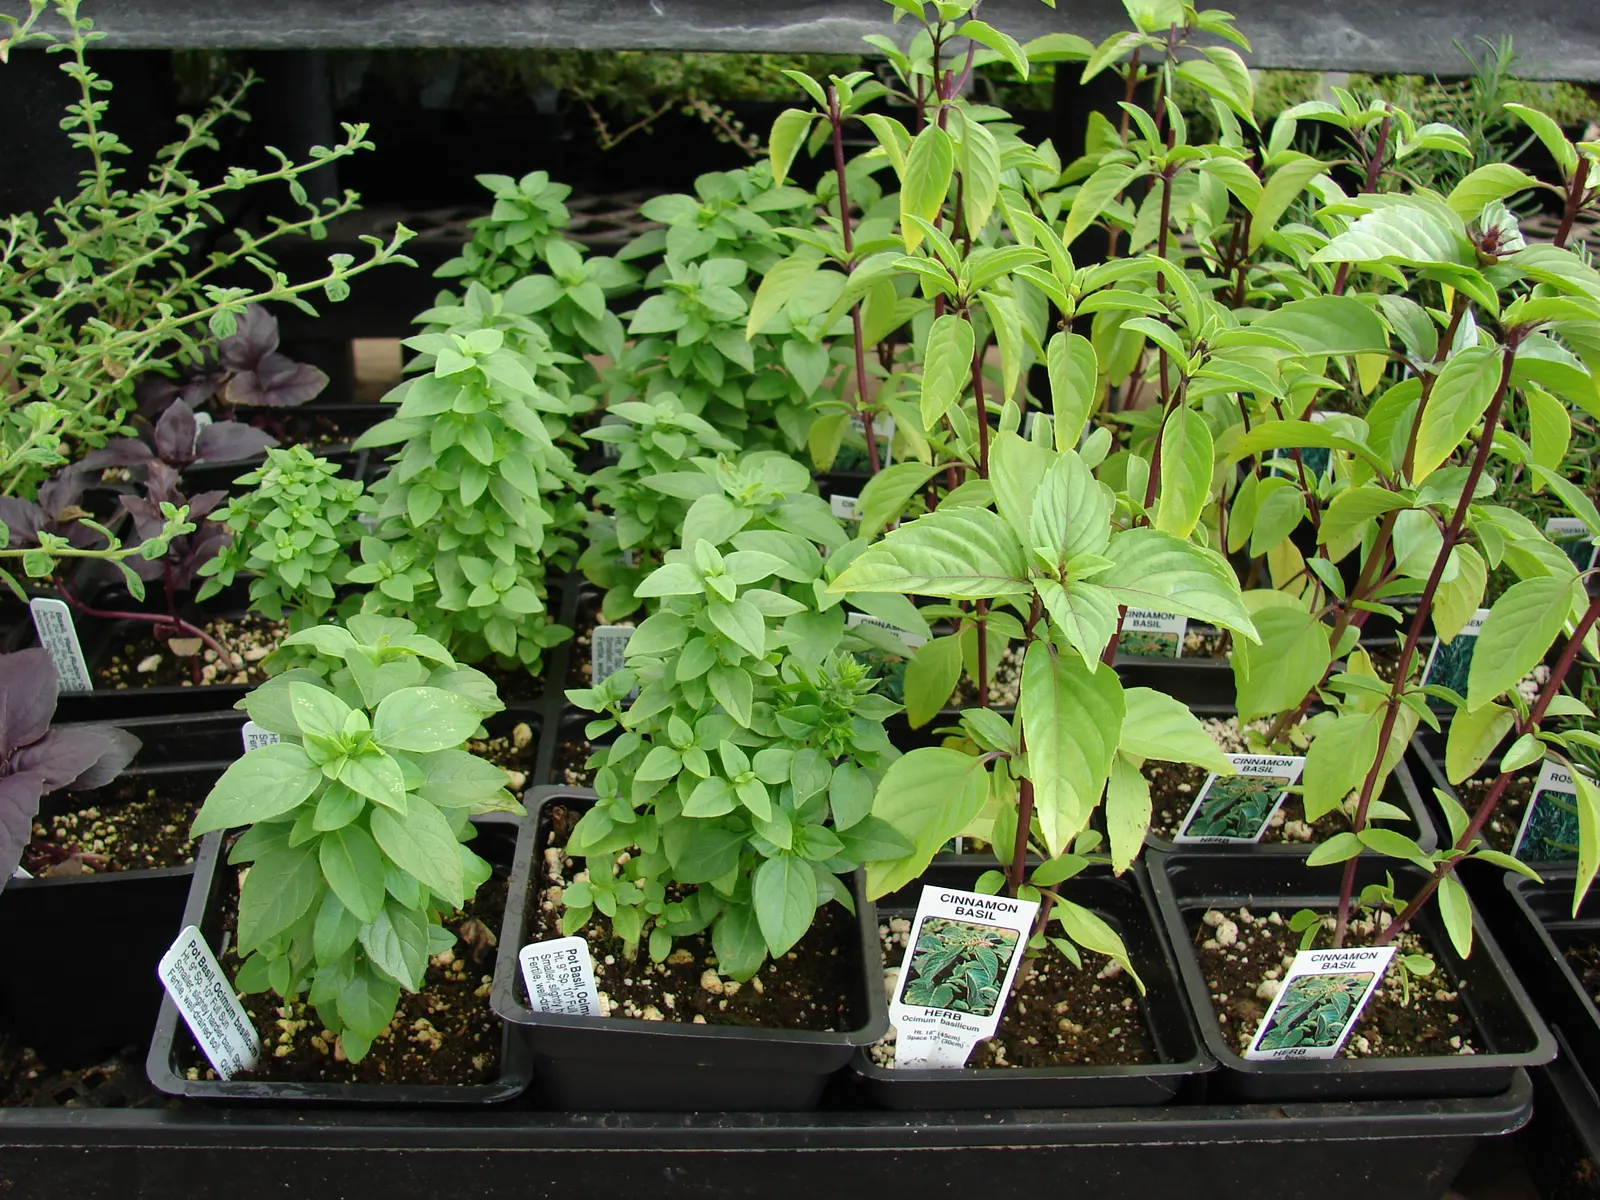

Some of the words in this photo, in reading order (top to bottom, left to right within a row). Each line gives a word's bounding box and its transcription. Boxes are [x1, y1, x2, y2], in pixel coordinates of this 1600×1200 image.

[1132, 619, 1162, 629] BASIL
[1232, 757, 1294, 767] CINNAMON
[1242, 765, 1275, 774] BASIL
[940, 893, 1019, 913] CINNAMON
[955, 906, 997, 921] BASIL
[565, 948, 579, 965] Pot
[1311, 951, 1378, 963] CINNAMON
[527, 955, 543, 982] Fertile,
[540, 953, 556, 983] Smaller,
[1321, 961, 1357, 970] BASIL
[166, 967, 183, 998] Fertile,
[558, 972, 570, 985] Sp.
[569, 965, 585, 990] Basil,
[186, 939, 202, 960] Pot
[196, 956, 215, 986] Basil,
[211, 981, 237, 1020] Ocimum
[232, 1017, 258, 1058] basilicum
[218, 1011, 230, 1029] Sun
[924, 1008, 962, 1020] HERB
[902, 1015, 936, 1024] Ocimum
[940, 1018, 980, 1032] basilicum
[941, 1038, 964, 1049] (30cm)
[1273, 1048, 1307, 1057] HERB
